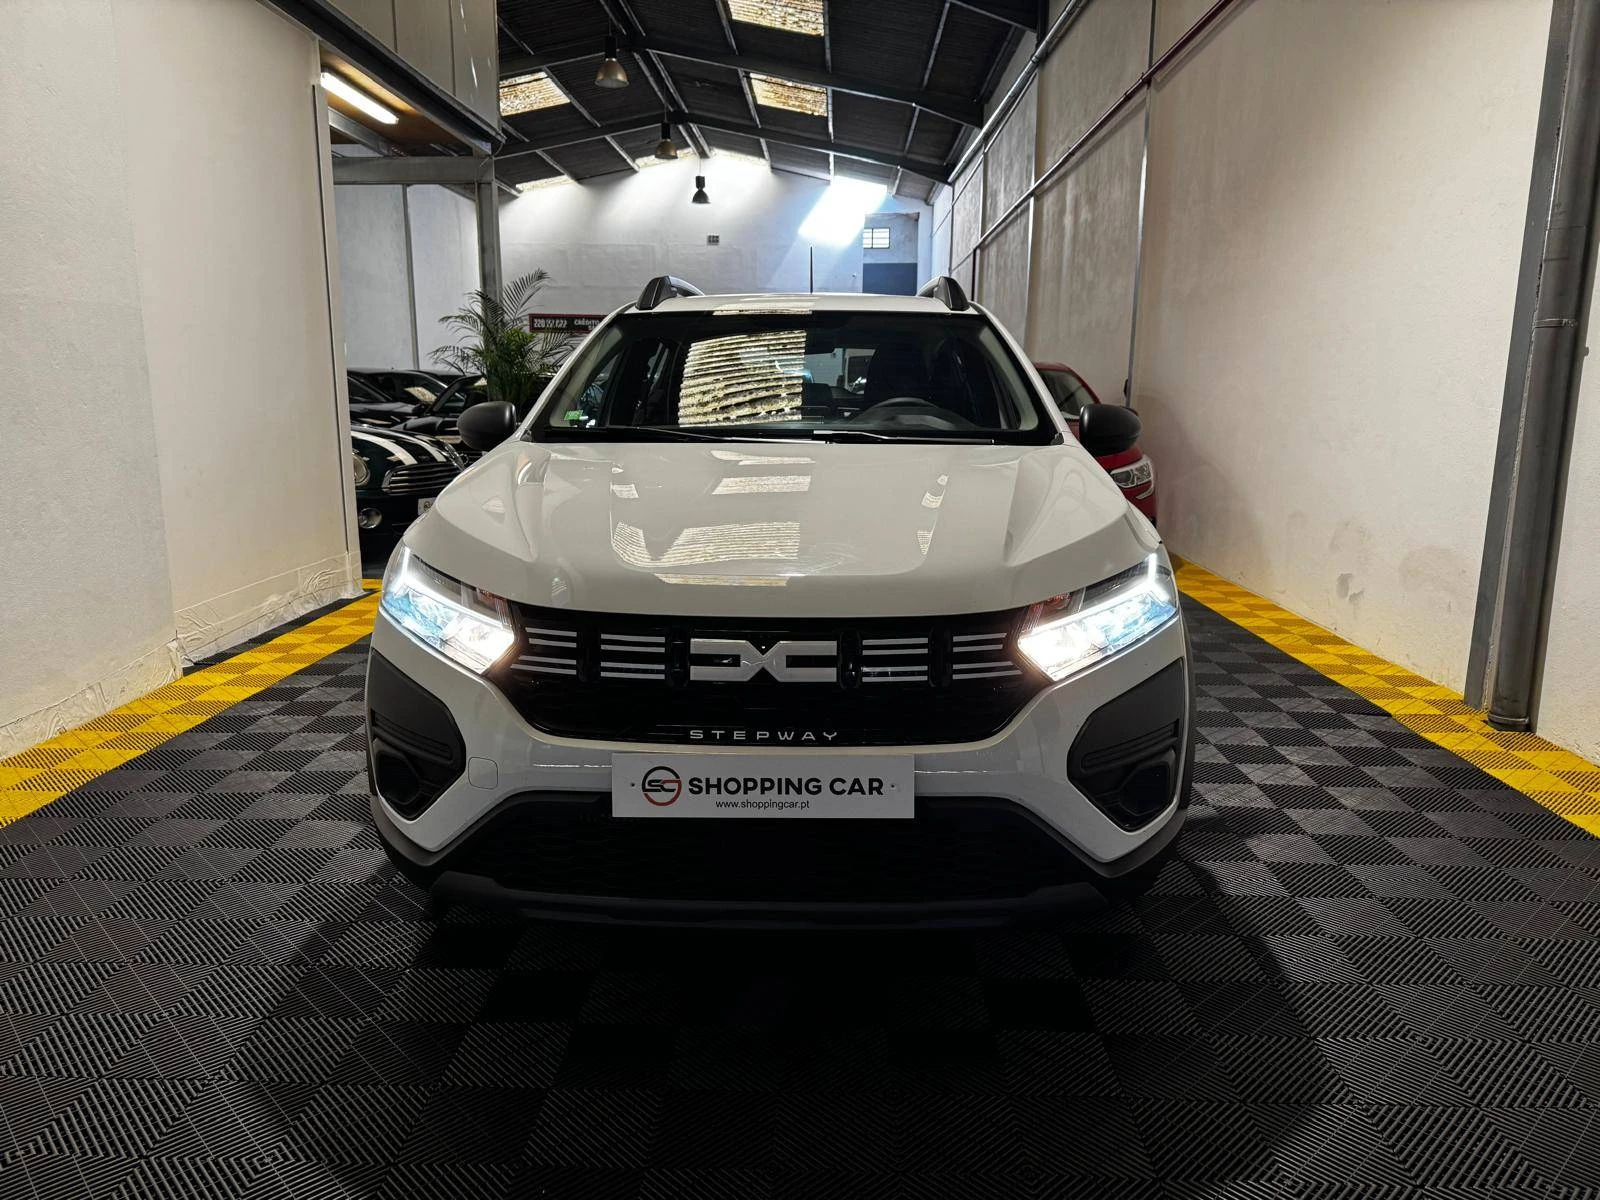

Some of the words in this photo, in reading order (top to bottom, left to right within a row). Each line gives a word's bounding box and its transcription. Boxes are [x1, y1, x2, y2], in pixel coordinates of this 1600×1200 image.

[690, 730, 837, 741] STEPWAY
[688, 777, 822, 795] SHOPPING
[828, 778, 884, 795] CAR
[715, 799, 810, 810] www.shoppingcar.pt
